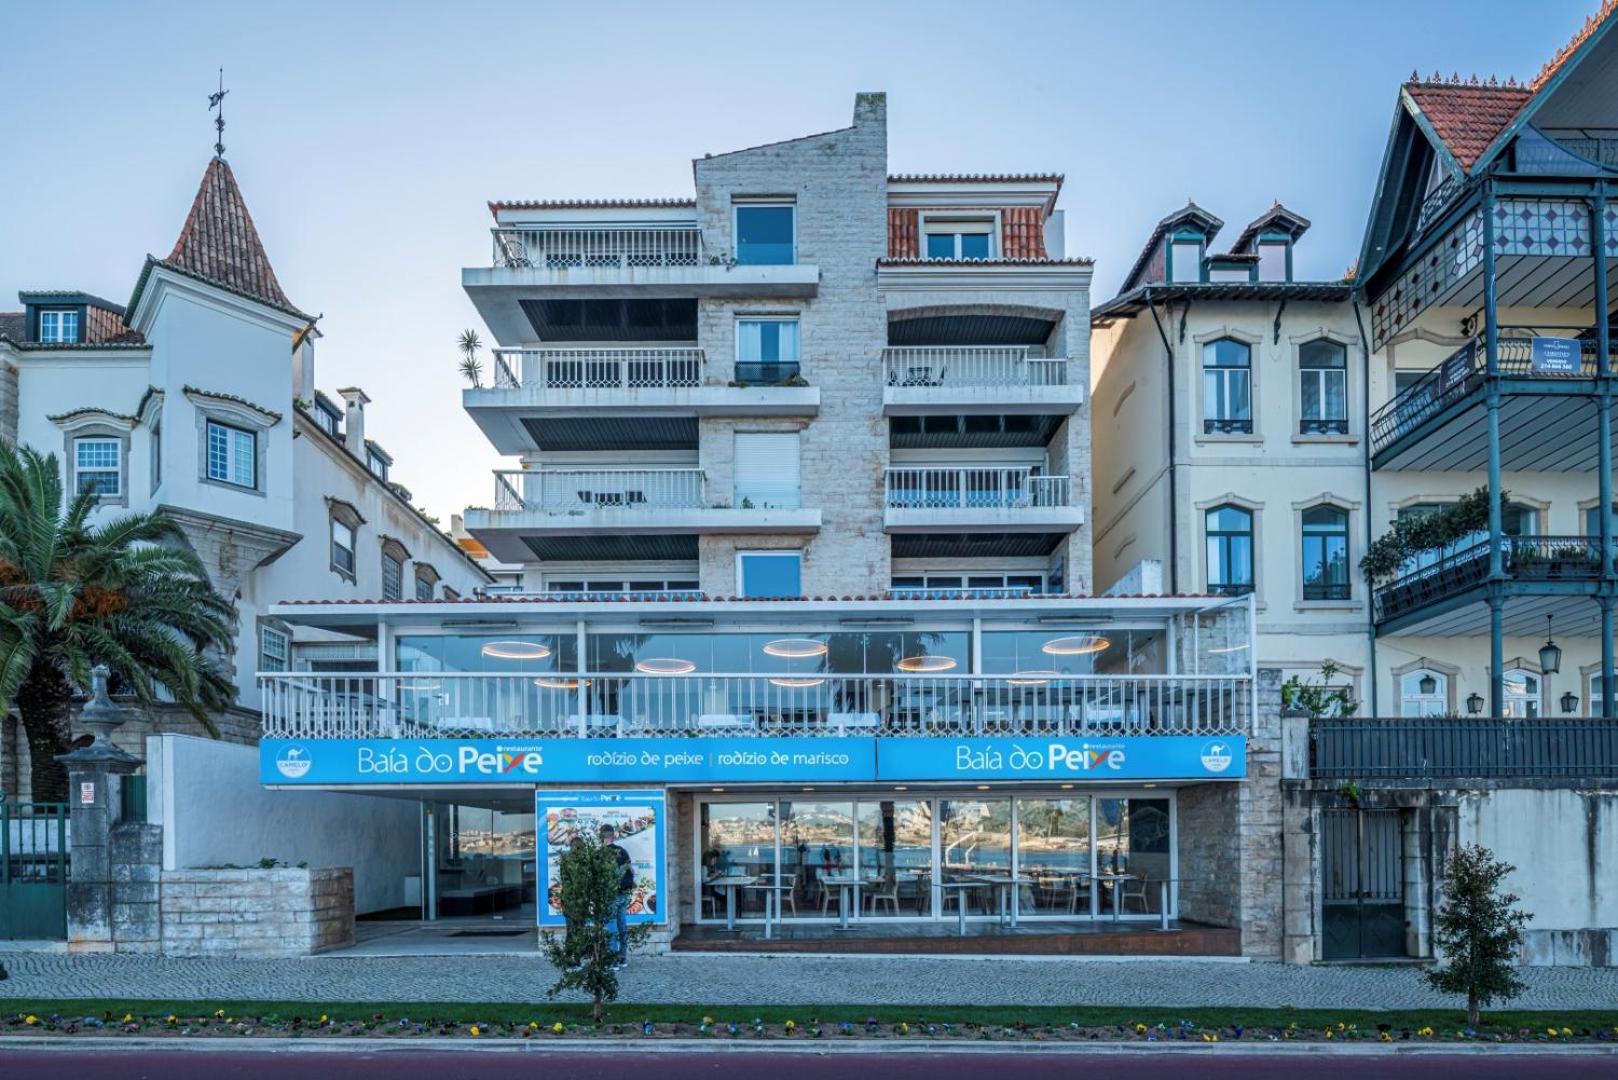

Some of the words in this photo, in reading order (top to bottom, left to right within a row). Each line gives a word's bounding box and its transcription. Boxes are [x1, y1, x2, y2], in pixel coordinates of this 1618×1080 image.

[358, 747, 409, 773] Baía
[415, 746, 453, 773] do
[458, 746, 543, 774] Peixe
[587, 751, 637, 766] rodízio
[640, 750, 660, 766] de
[664, 752, 704, 768] peixe
[718, 751, 767, 765] rodízio
[770, 751, 789, 765] de
[793, 752, 849, 765] marisco
[956, 745, 1002, 770] Baía
[1009, 744, 1043, 770] do
[1048, 743, 1126, 771] Peixe
